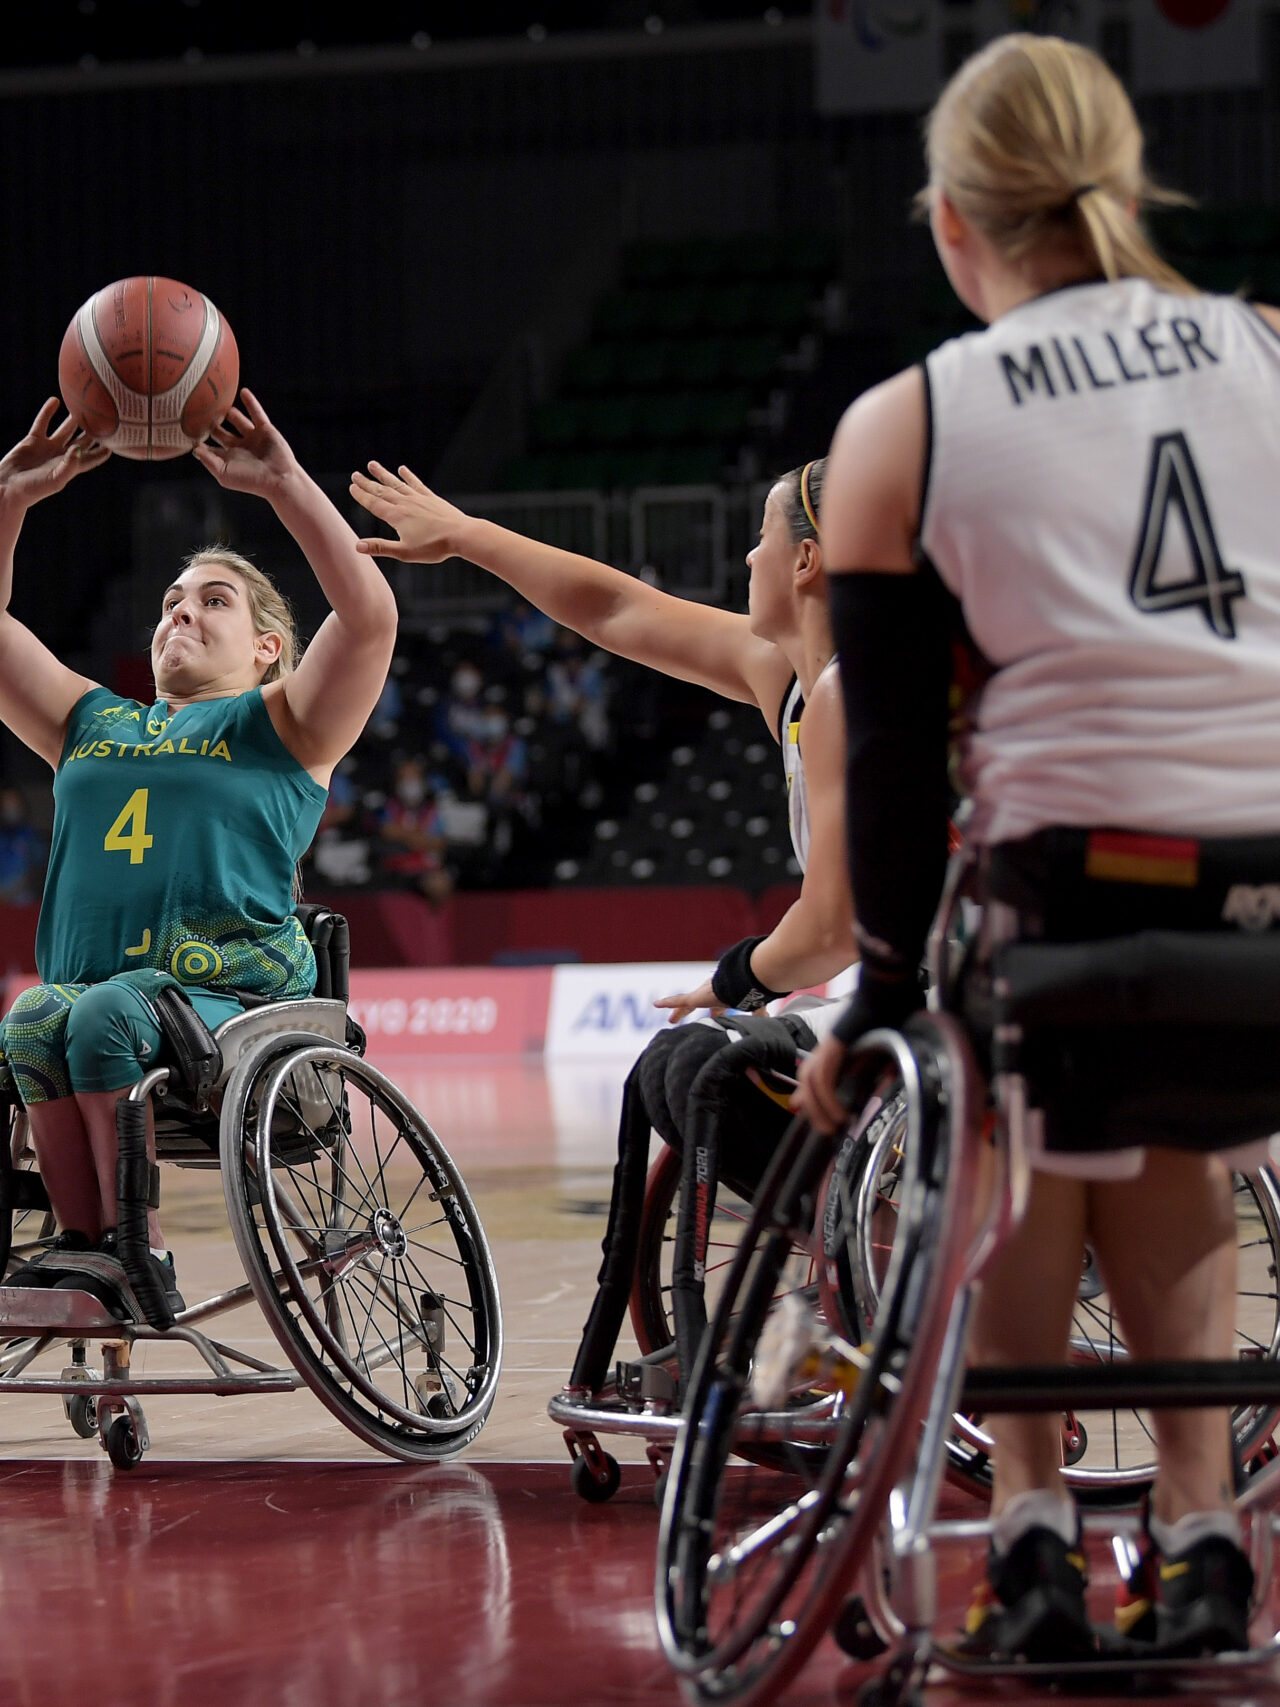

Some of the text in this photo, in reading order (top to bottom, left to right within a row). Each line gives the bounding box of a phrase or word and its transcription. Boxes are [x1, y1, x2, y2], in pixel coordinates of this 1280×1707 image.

[1001, 317, 1219, 407] MILLER
[1129, 429, 1246, 641] 4
[104, 787, 154, 865] 4
[408, 996, 498, 1035] 2020
